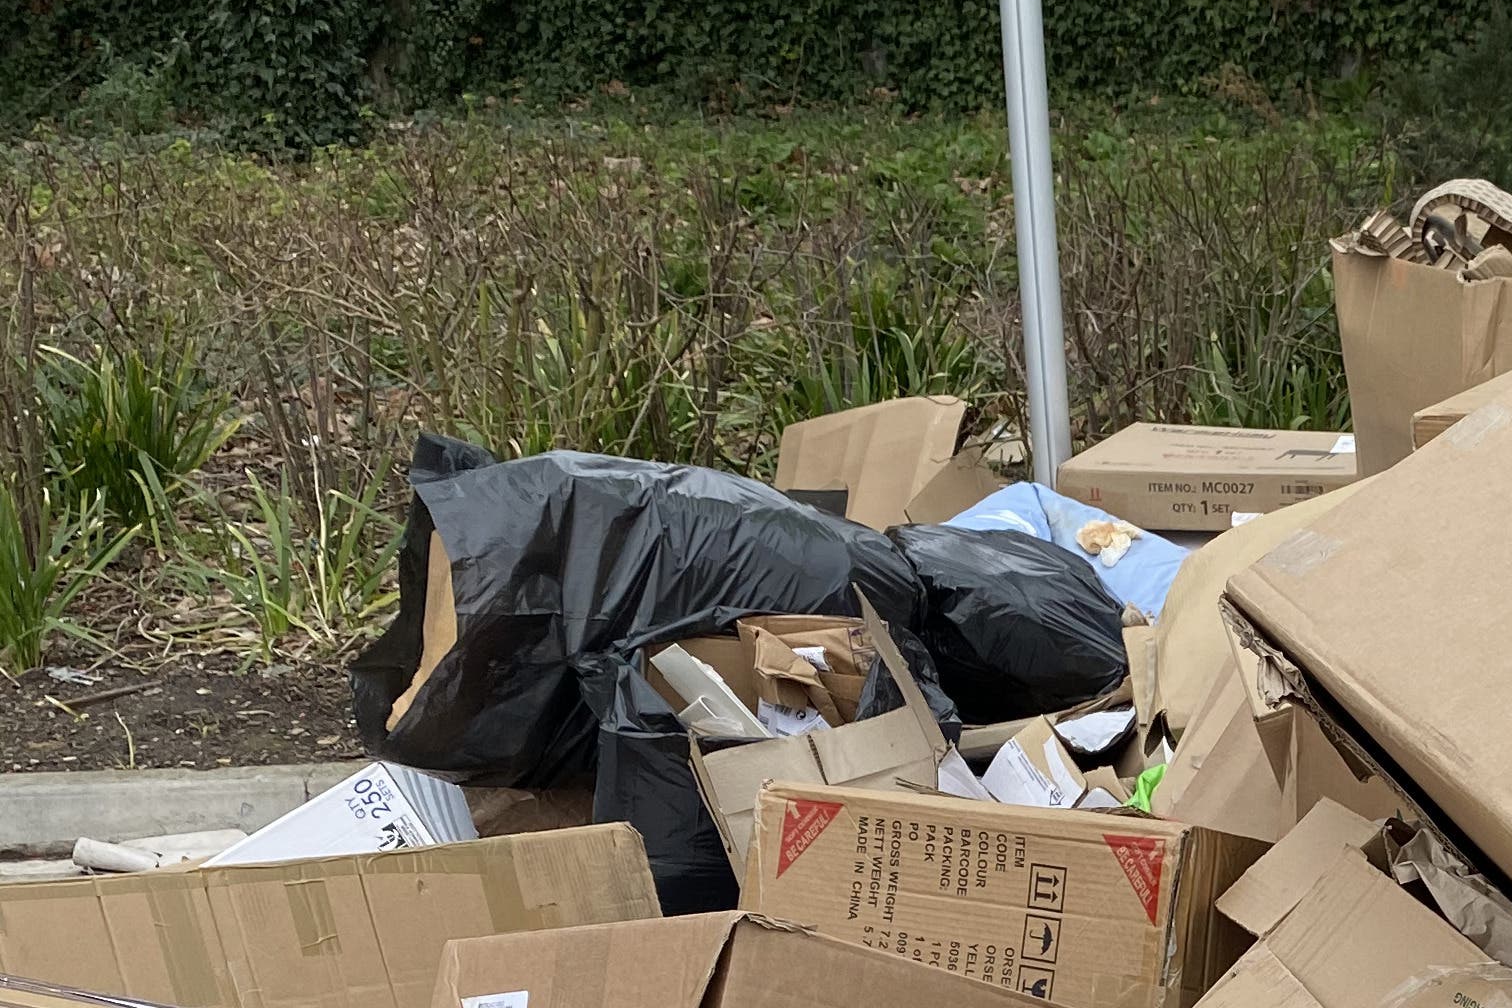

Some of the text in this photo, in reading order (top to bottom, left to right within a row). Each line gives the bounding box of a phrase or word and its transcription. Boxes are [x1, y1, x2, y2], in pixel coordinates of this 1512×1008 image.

[1149, 483, 1173, 492] ITEM
[1202, 482, 1254, 494] MC0027
[1201, 501, 1208, 515] 1
[1212, 504, 1230, 513] SET
[344, 797, 366, 819] QTY
[354, 779, 391, 819] 250
[874, 818, 885, 852] NETT
[909, 823, 919, 841] PO
[924, 825, 936, 862] PACK
[786, 845, 799, 861] BE
[848, 816, 869, 920] MADE IN CHINA
[940, 827, 953, 889] PACKING:
[976, 831, 989, 888] COLOUR
[995, 834, 1007, 872] CODE
[868, 857, 882, 907] WEIGHT
[878, 820, 902, 949] GROSS WEIGHT 7.2
[947, 829, 971, 970] BARCODE 5036
[1001, 836, 1025, 988] ITEM ORSE
